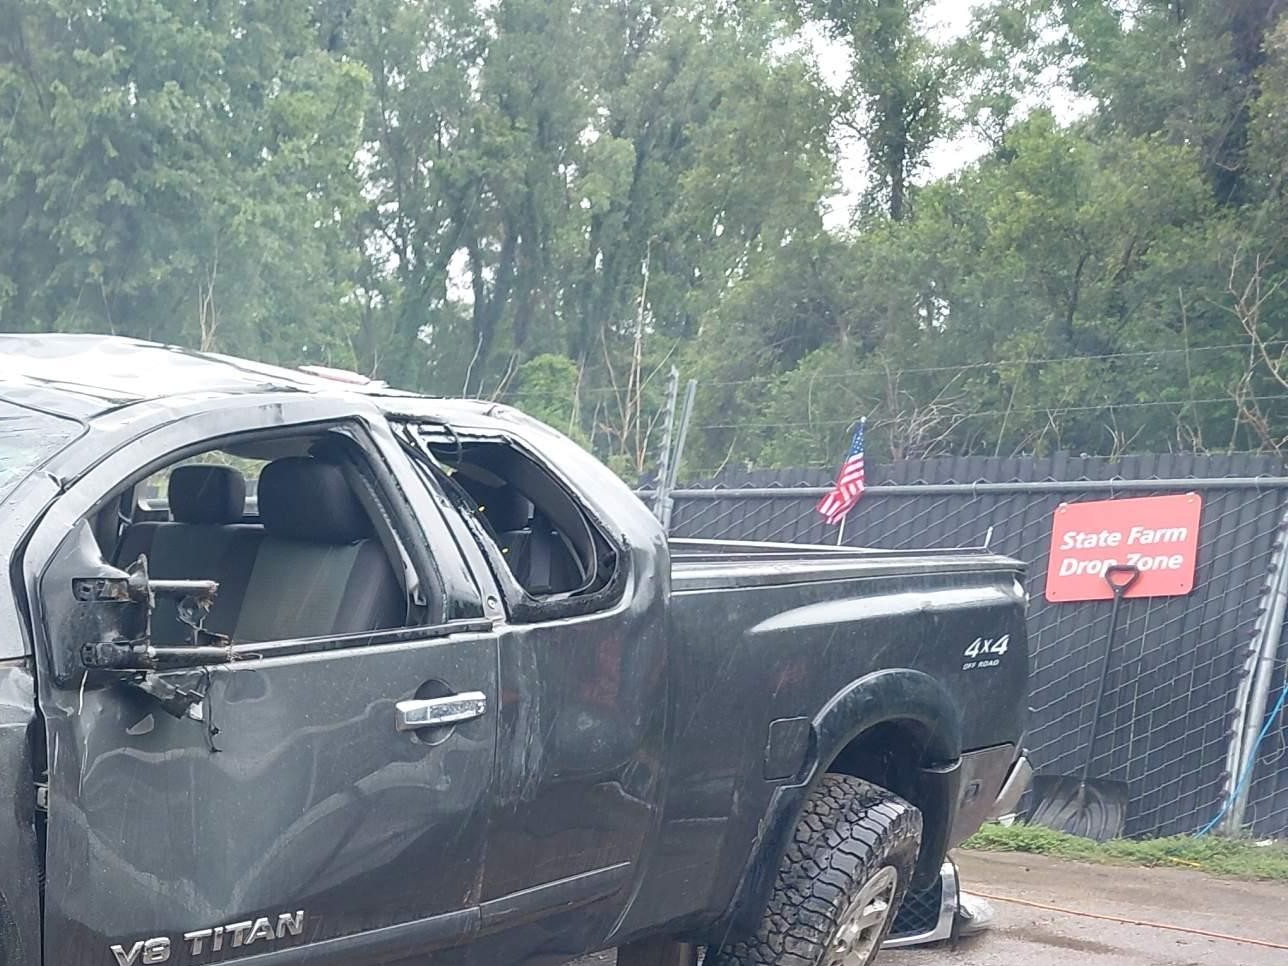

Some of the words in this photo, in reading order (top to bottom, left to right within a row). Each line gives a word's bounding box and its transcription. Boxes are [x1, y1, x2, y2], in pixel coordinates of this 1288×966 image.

[1059, 530, 1122, 550] State
[1127, 526, 1188, 545] Farm
[961, 661, 977, 671] OFF
[977, 658, 1000, 668] ROAD
[183, 909, 305, 956] TITAN
